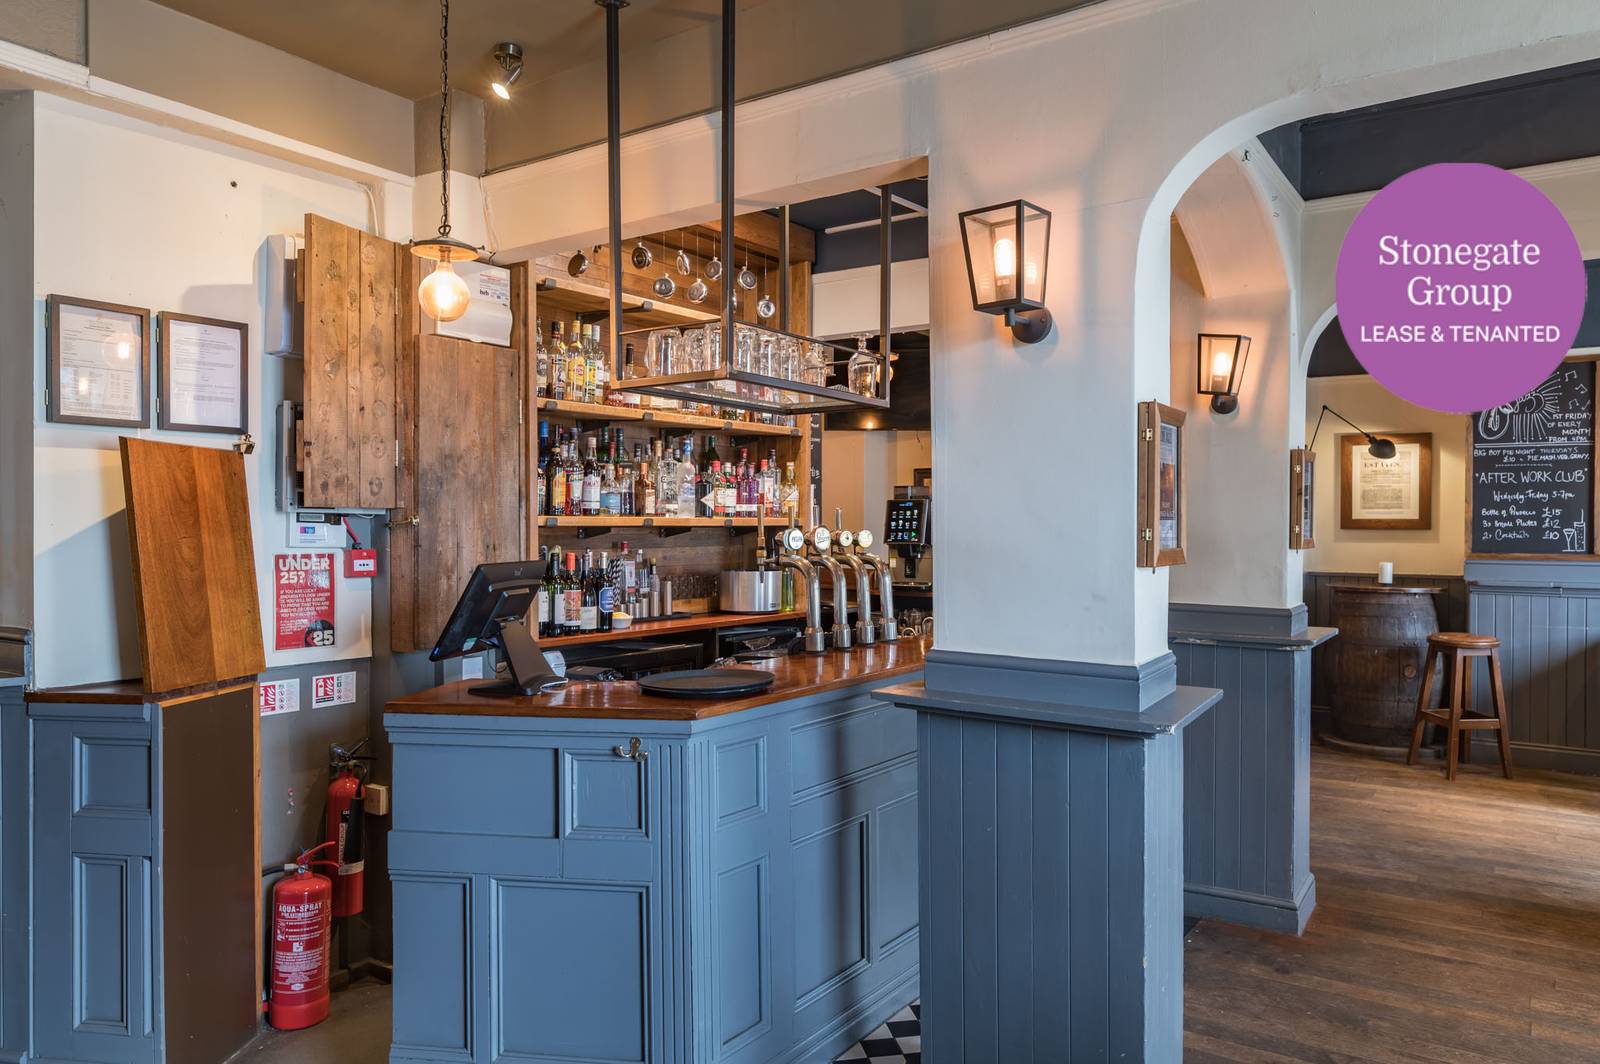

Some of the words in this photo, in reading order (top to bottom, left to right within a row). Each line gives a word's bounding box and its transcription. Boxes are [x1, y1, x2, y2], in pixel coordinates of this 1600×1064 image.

[1565, 412, 1592, 420] FRIDAY
[1562, 428, 1591, 436] MONTH
[1474, 449, 1487, 457] BIG
[1521, 470, 1552, 483] WORK
[1481, 508, 1500, 516] Bottle
[1541, 506, 1562, 518] £15
[1541, 518, 1561, 529] £12
[1541, 530, 1560, 540] £10
[278, 558, 330, 571] UNDER
[280, 571, 306, 584] 25?
[313, 629, 334, 646] 25
[279, 903, 322, 913] AQUA-SPRAY
